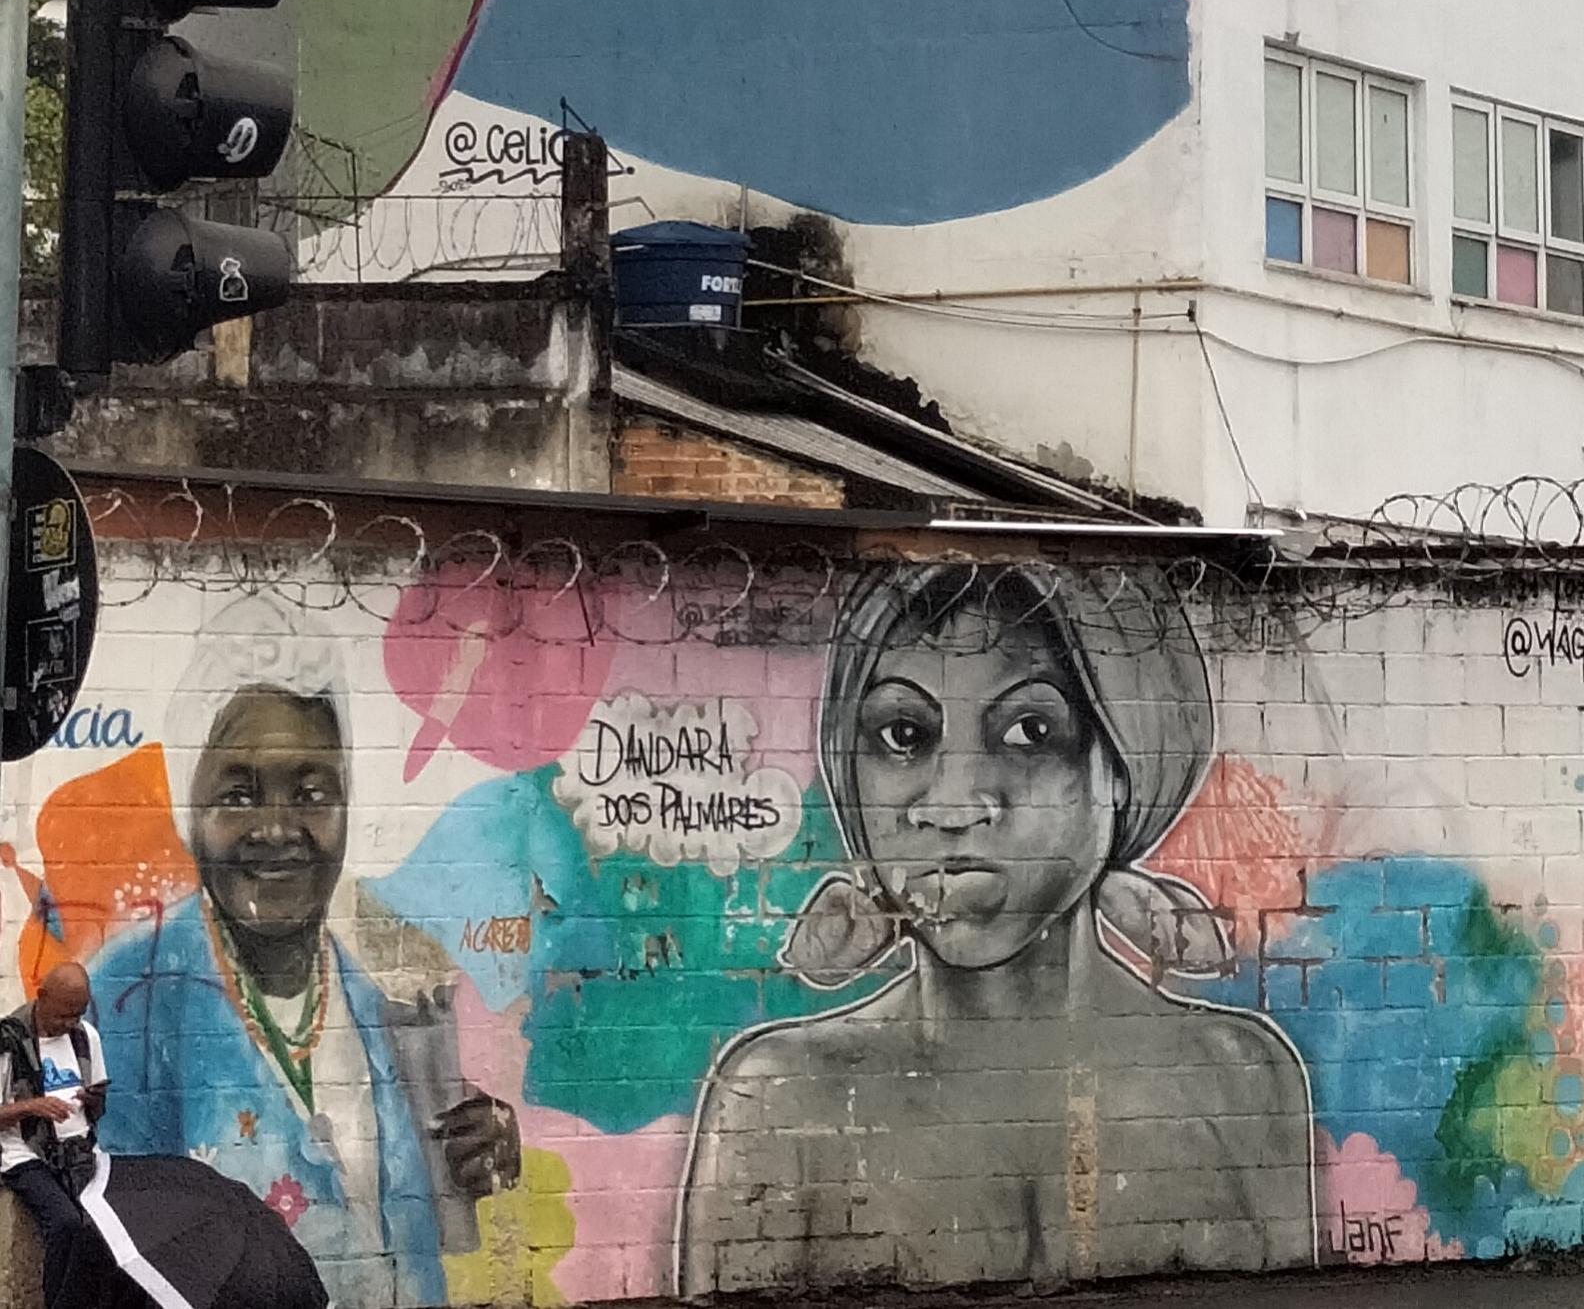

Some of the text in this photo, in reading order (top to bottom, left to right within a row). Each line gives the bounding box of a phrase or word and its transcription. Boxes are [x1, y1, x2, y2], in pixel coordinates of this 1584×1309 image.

[53, 702, 144, 749] cia
[578, 718, 734, 787] DANDARA
[598, 781, 781, 837] DOS PALMARES
